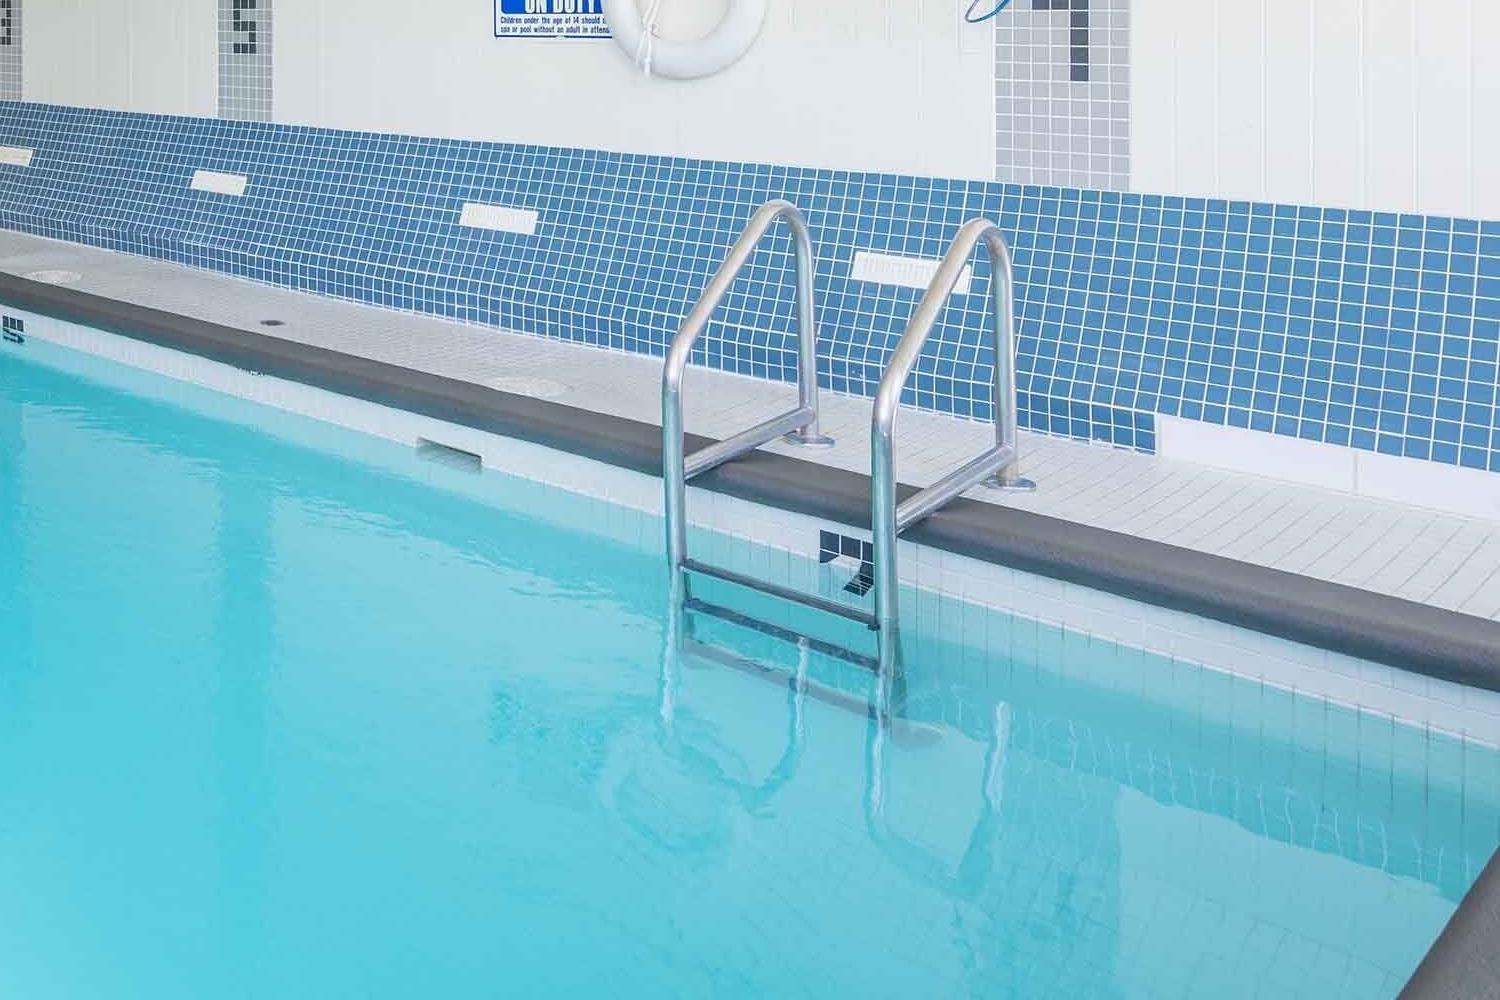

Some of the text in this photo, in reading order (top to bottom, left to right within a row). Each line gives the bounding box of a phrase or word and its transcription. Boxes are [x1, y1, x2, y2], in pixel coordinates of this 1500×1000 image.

[500, 16, 522, 24] Children
[524, 16, 539, 24] under
[542, 16, 550, 24] the
[553, 17, 563, 25] age
[565, 16, 571, 24] of
[581, 16, 600, 24] should
[233, 0, 256, 54] 5
[520, 25, 532, 34] pool
[534, 25, 555, 33] without
[566, 25, 580, 33] adult
